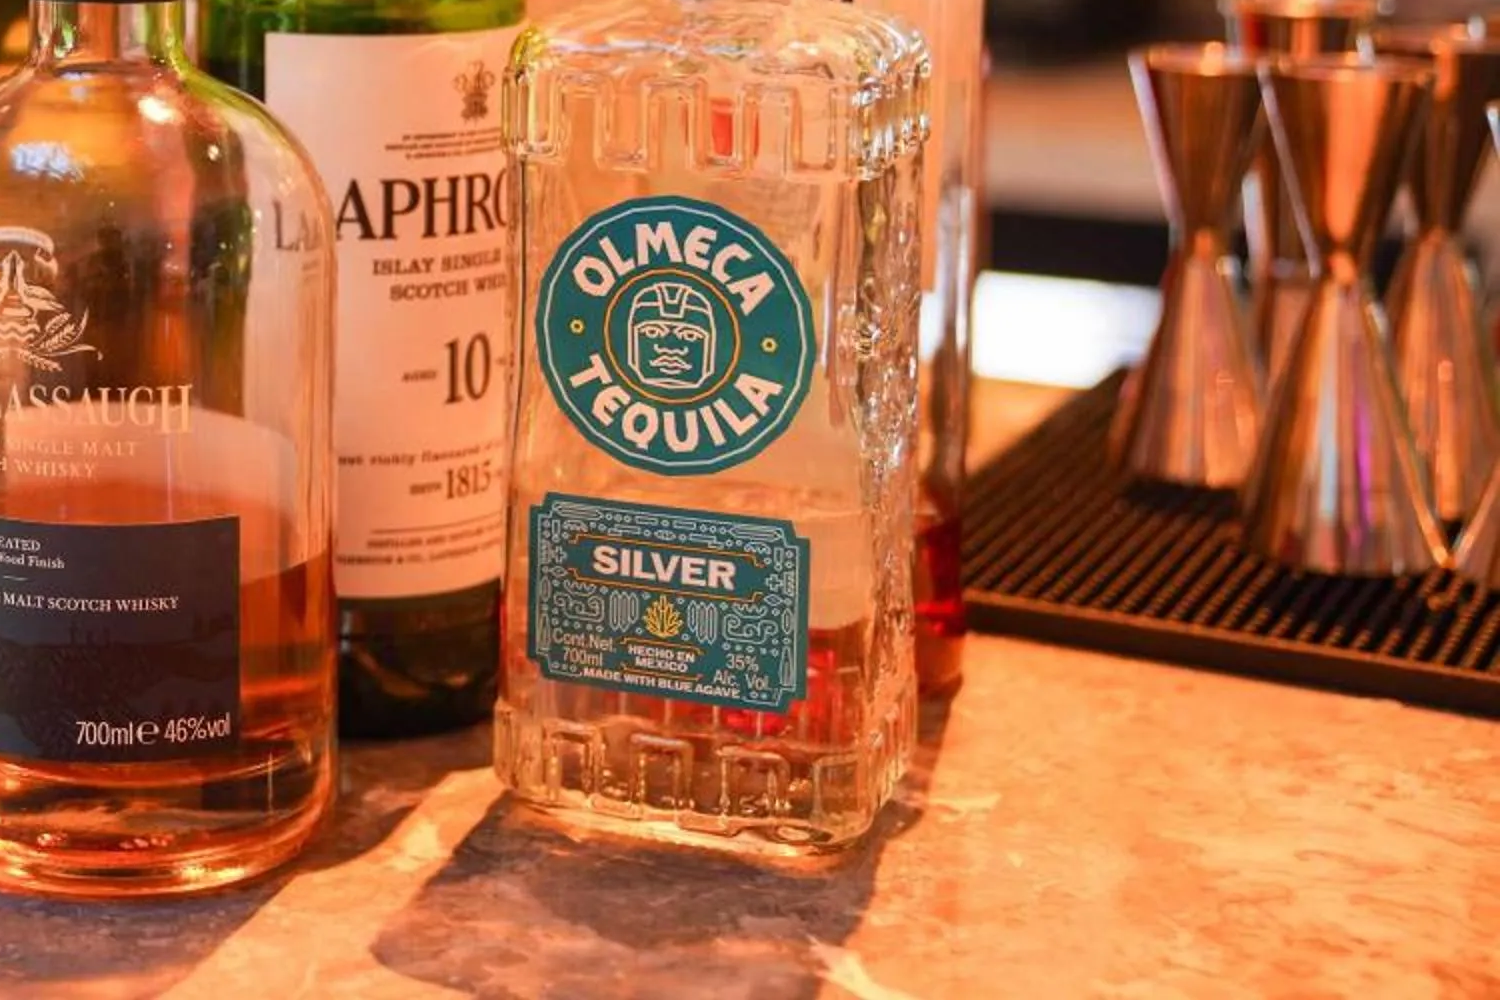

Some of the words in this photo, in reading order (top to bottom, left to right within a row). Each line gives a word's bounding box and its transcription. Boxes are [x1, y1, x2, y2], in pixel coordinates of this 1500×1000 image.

[372, 257, 434, 277] ISLAY
[572, 221, 775, 316] OLMECA
[390, 279, 468, 302] SCOTCH
[445, 332, 491, 404] 10
[569, 354, 783, 452] TEQUILA
[82, 440, 137, 457] MALT
[14, 458, 97, 479] WHISKY
[446, 460, 492, 499] 1815
[28, 554, 65, 570] Finish
[592, 545, 736, 591] SILVER
[3, 590, 45, 609] MALT
[47, 597, 111, 613] SCOTCH
[116, 595, 180, 613] WHISKY
[562, 646, 603, 667] 700ml
[628, 643, 673, 660] HECHO
[677, 650, 696, 663] EN
[726, 652, 760, 673] 35%
[583, 667, 621, 683] MADE
[624, 673, 656, 688] WITH
[658, 678, 692, 693] BLUE
[695, 682, 741, 700] AGAVE
[712, 669, 739, 688] Alc.
